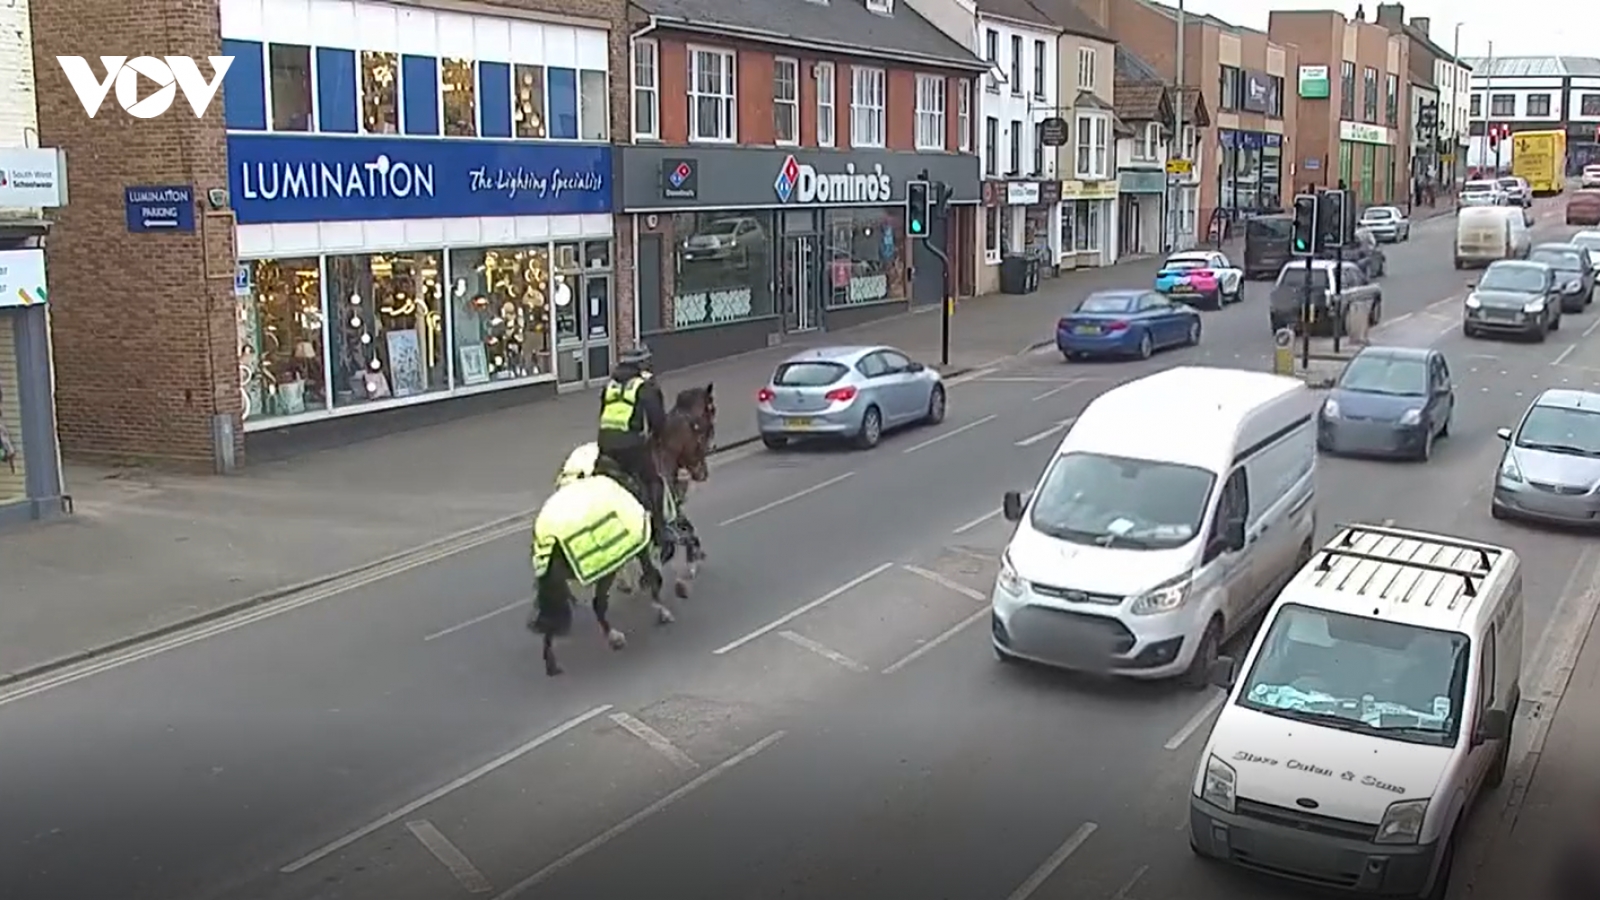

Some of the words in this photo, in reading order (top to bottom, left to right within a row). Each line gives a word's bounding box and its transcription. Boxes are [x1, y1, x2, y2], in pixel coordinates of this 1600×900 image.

[12, 170, 33, 178] South
[242, 154, 434, 199] LUMINATION
[469, 165, 493, 191] The
[497, 166, 547, 199] Lighting
[551, 168, 602, 198] Specialist
[798, 163, 891, 202] Domino's
[13, 180, 53, 188] Schoolwear
[129, 189, 189, 202] LUMINATION
[142, 207, 178, 217] PARKING
[1340, 771, 1356, 782] &
[1360, 775, 1406, 795] Sons
